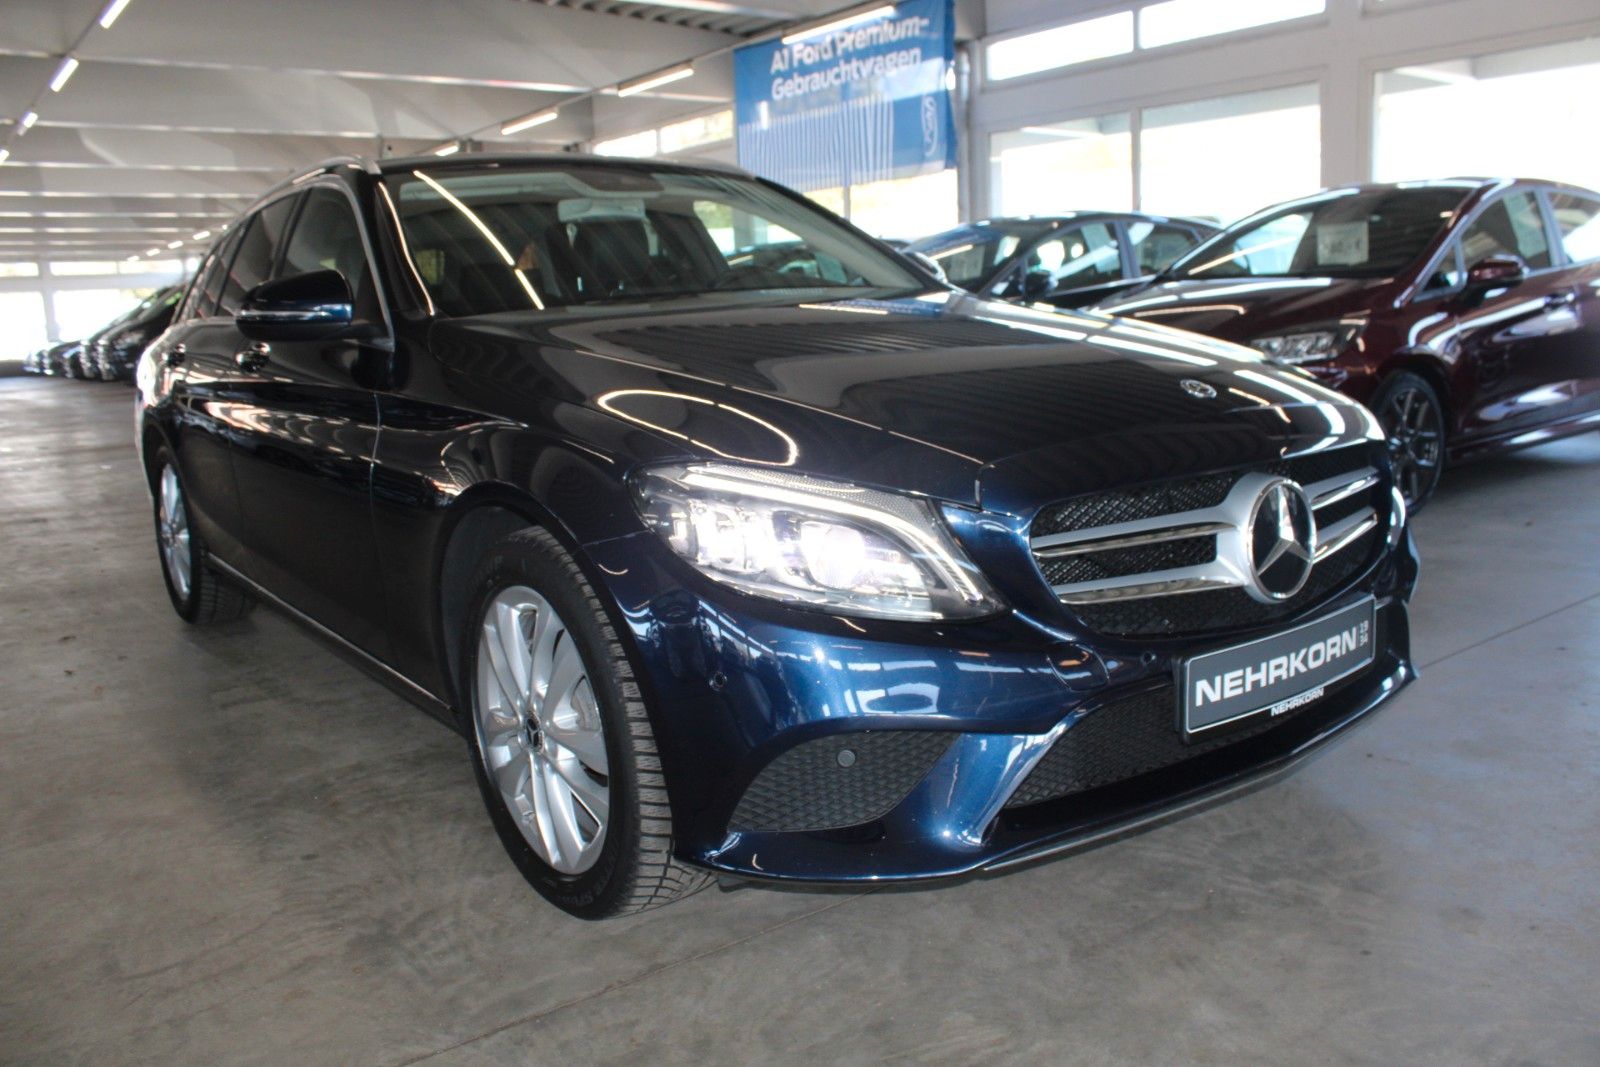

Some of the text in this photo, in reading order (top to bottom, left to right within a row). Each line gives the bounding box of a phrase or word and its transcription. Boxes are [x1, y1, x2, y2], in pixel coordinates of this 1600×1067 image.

[793, 36, 832, 66] Ford
[1195, 626, 1357, 707] NEHRKORN
[1271, 687, 1324, 717] NEHRKORN
